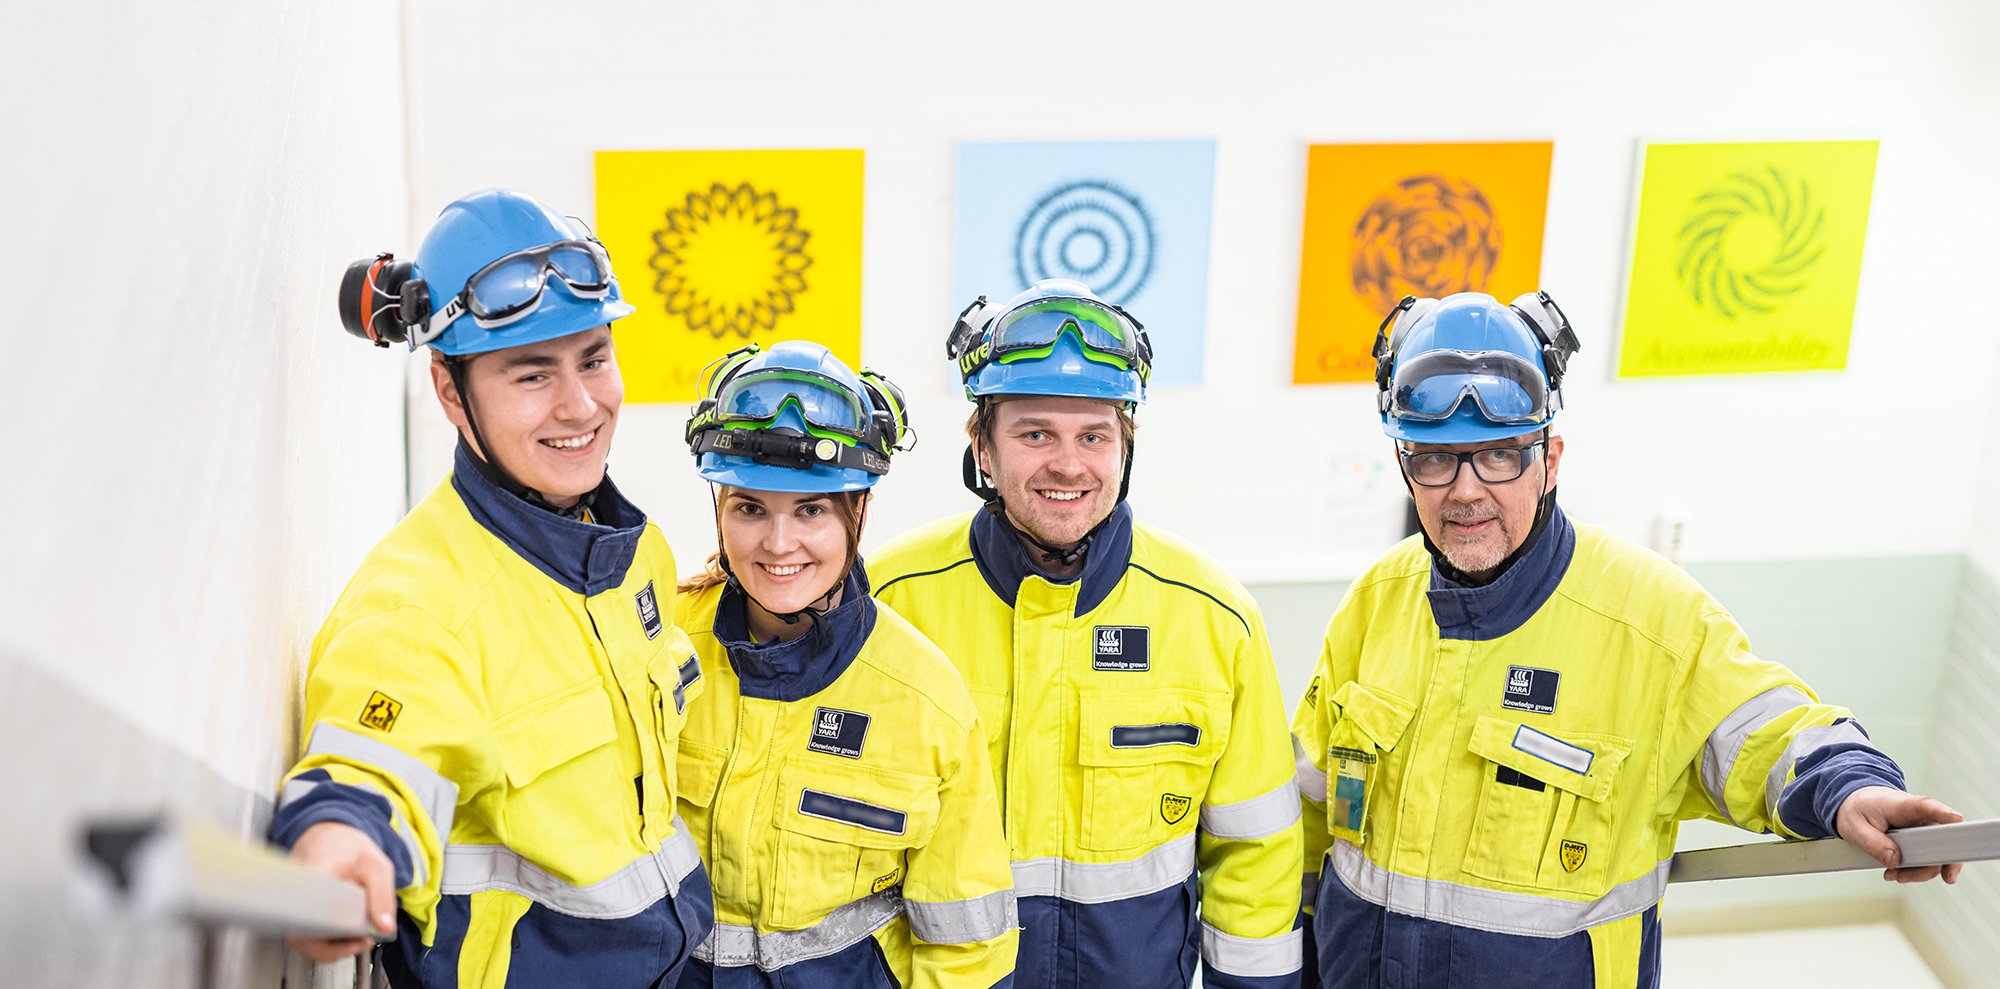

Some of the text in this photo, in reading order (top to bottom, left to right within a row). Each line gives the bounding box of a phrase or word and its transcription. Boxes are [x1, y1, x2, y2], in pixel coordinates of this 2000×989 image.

[1096, 661, 1128, 669] Knowledge
[1509, 685, 1528, 694] YARA
[1504, 698, 1553, 712] Knowledge grows
[818, 728, 837, 737] YARA
[811, 741, 859, 756] Knowledge grows
